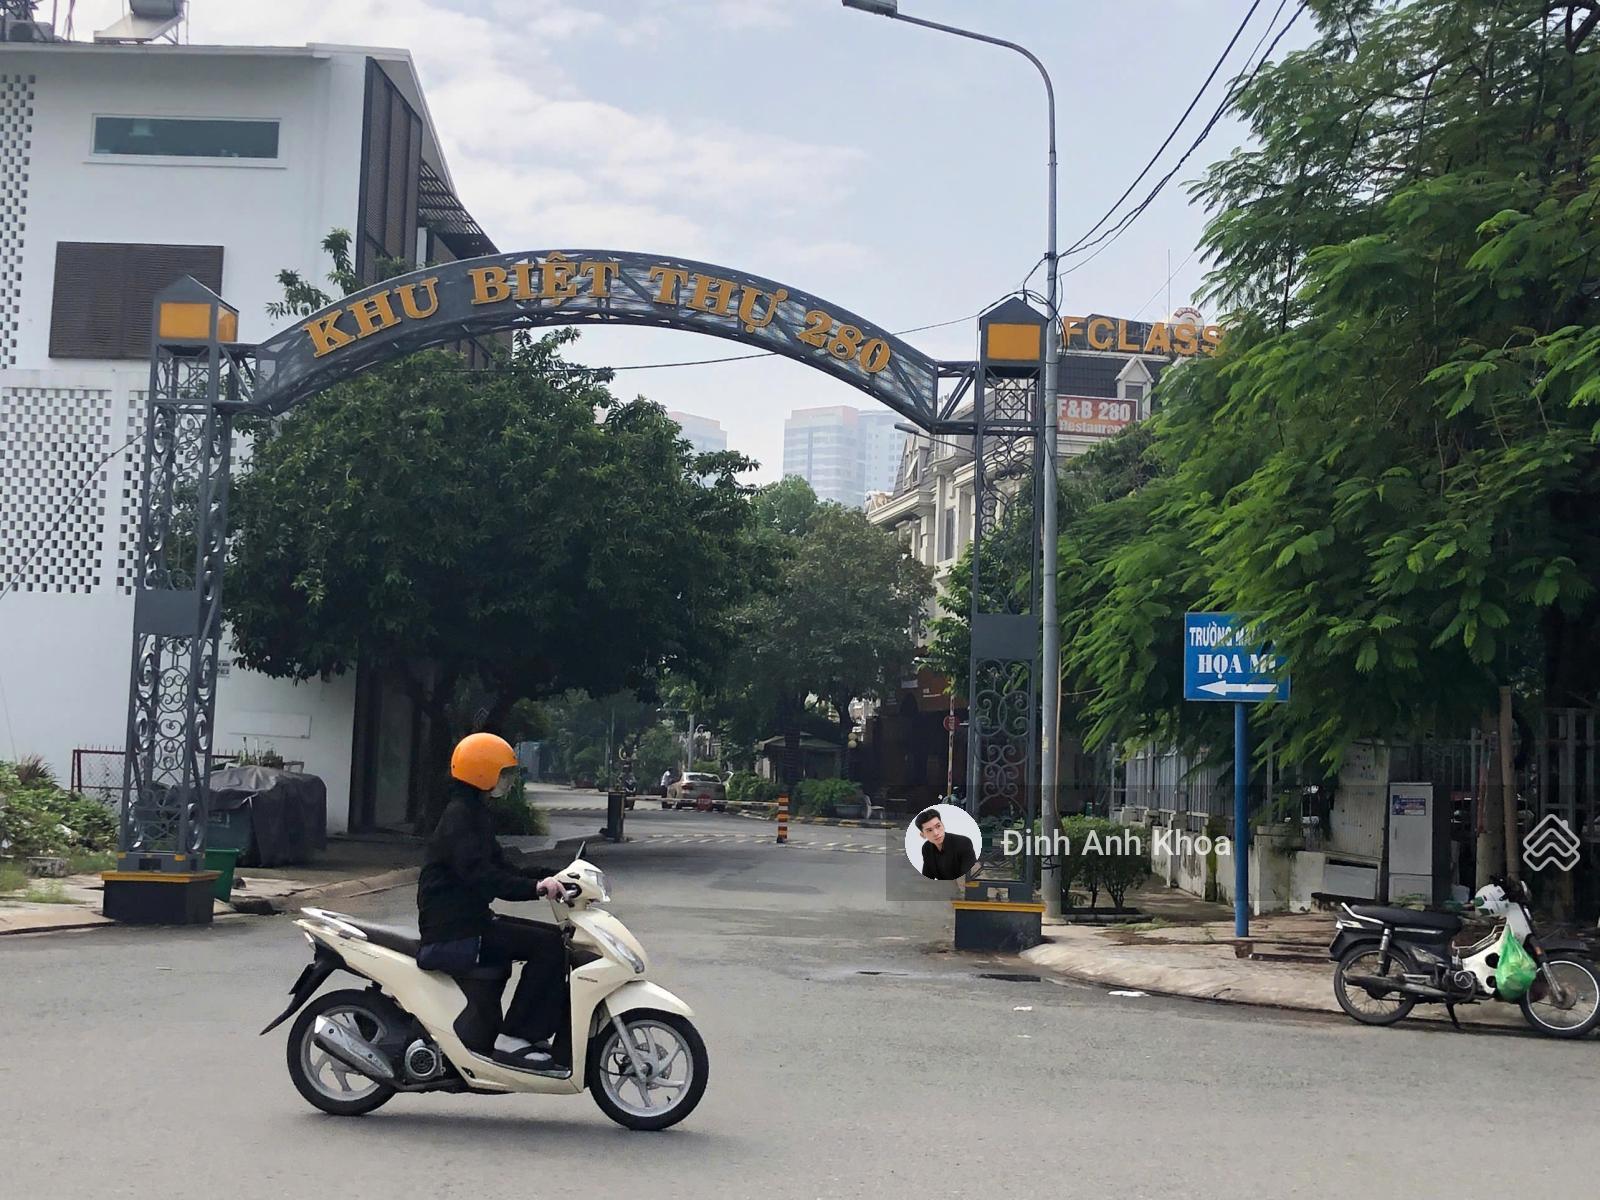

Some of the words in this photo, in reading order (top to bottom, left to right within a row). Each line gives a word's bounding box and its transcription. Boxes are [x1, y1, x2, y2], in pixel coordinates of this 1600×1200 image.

[303, 276, 440, 358] KHU
[467, 251, 619, 305] BIỆT
[650, 265, 788, 333] THỰ
[796, 309, 891, 373] 280
[1057, 399, 1093, 419] F&B
[1098, 402, 1131, 421] 280
[1197, 654, 1243, 679] HỌA
